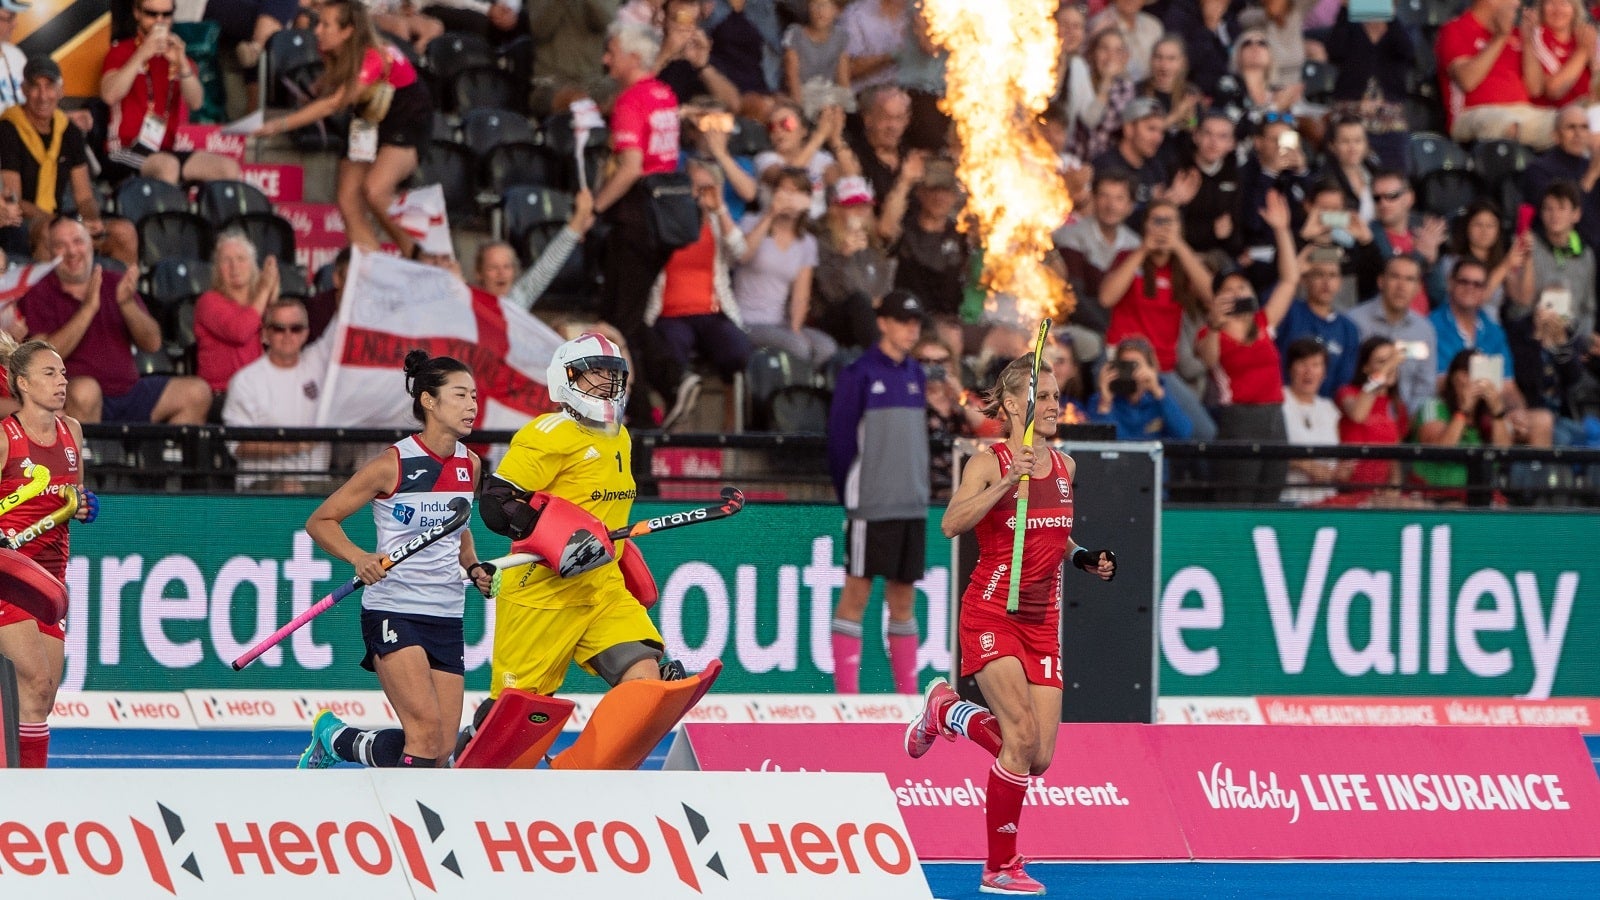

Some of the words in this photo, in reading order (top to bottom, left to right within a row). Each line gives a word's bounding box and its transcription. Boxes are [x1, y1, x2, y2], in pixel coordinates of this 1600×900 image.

[615, 451, 622, 473] 1
[603, 488, 636, 501] Investe
[420, 501, 451, 513] Indus
[1026, 515, 1073, 529] nveste
[660, 536, 846, 674] out
[1252, 524, 1580, 700] Valley
[382, 619, 398, 643] 4
[130, 702, 180, 719] Hero
[226, 699, 276, 717] Hero
[767, 704, 816, 720] Hero
[854, 704, 904, 720] Hero
[1198, 761, 1300, 824] Vitality
[1300, 773, 1378, 811] LIFE
[1375, 773, 1570, 811] INSURANCE
[0, 821, 124, 876] ero
[215, 821, 393, 876] Hero
[474, 820, 651, 874] Hero
[738, 822, 912, 875] Hero
